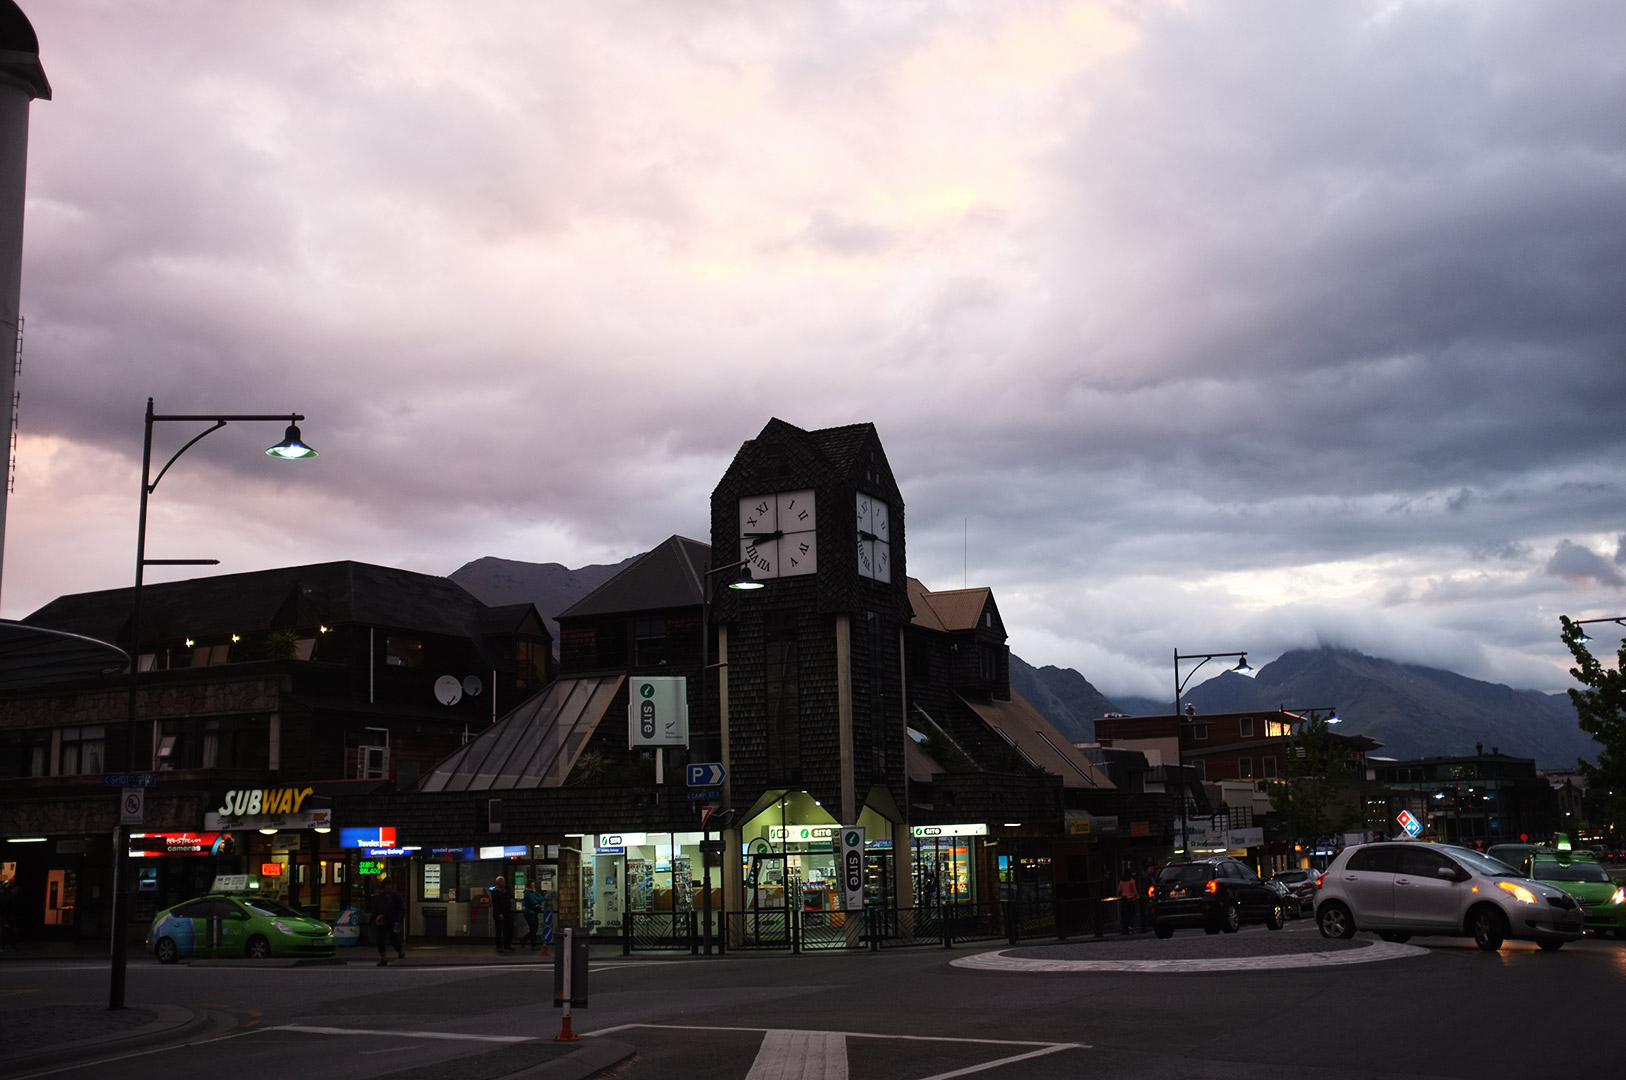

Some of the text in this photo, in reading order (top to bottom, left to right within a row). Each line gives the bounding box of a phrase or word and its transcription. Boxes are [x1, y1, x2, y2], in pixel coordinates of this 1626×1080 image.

[756, 502, 769, 516] XI
[788, 500, 795, 510] I
[798, 510, 808, 520] II
[747, 516, 758, 527] X
[799, 542, 810, 556] IV
[790, 557, 798, 568] V
[692, 768, 704, 783] P
[218, 786, 314, 816] SUBWAY
[264, 865, 280, 874] OPEN
